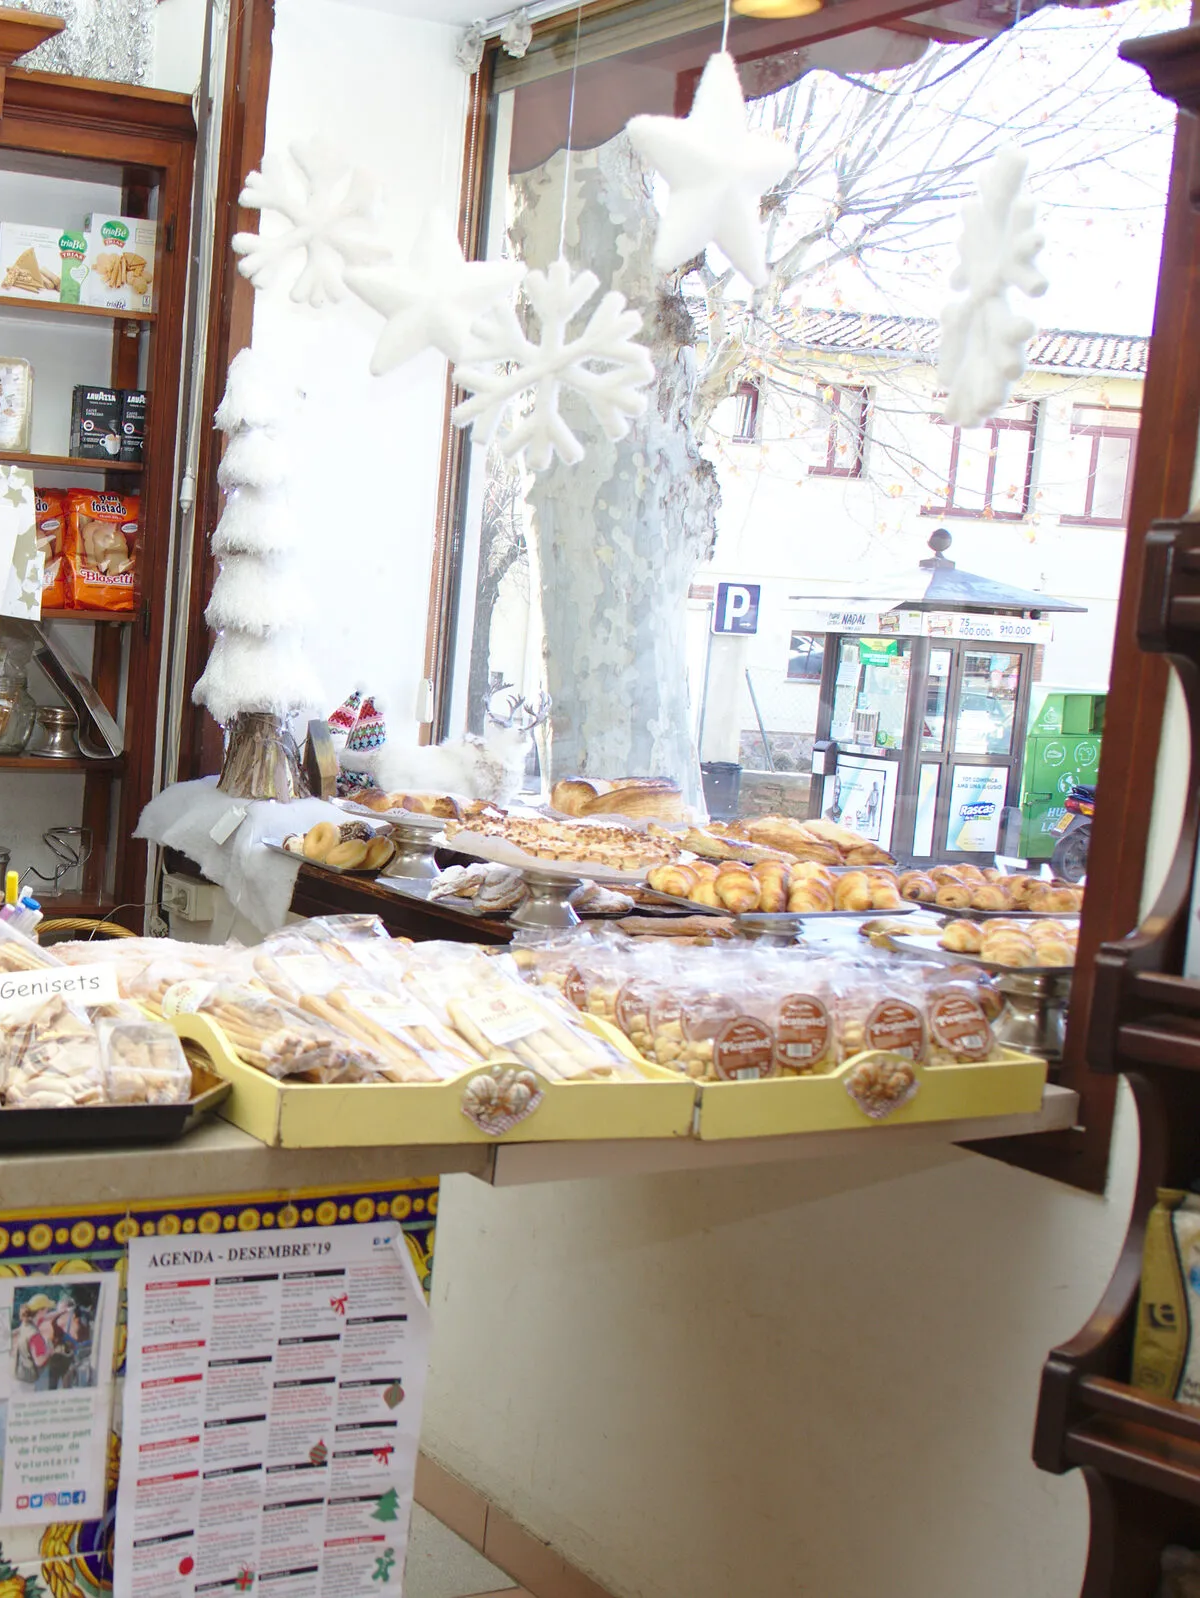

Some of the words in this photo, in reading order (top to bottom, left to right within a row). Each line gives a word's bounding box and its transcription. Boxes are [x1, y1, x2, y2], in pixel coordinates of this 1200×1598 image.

[86, 391, 117, 402] LAVAZZA
[91, 500, 127, 516] tostado
[83, 570, 133, 584] Blasetti
[724, 586, 749, 630] P
[841, 613, 867, 625] NADAL
[960, 618, 970, 627] 75
[1000, 624, 1031, 636] 910.000
[959, 803, 996, 817] Rascas
[0, 974, 101, 1000] Genisets
[148, 1250, 215, 1268] AGENDA
